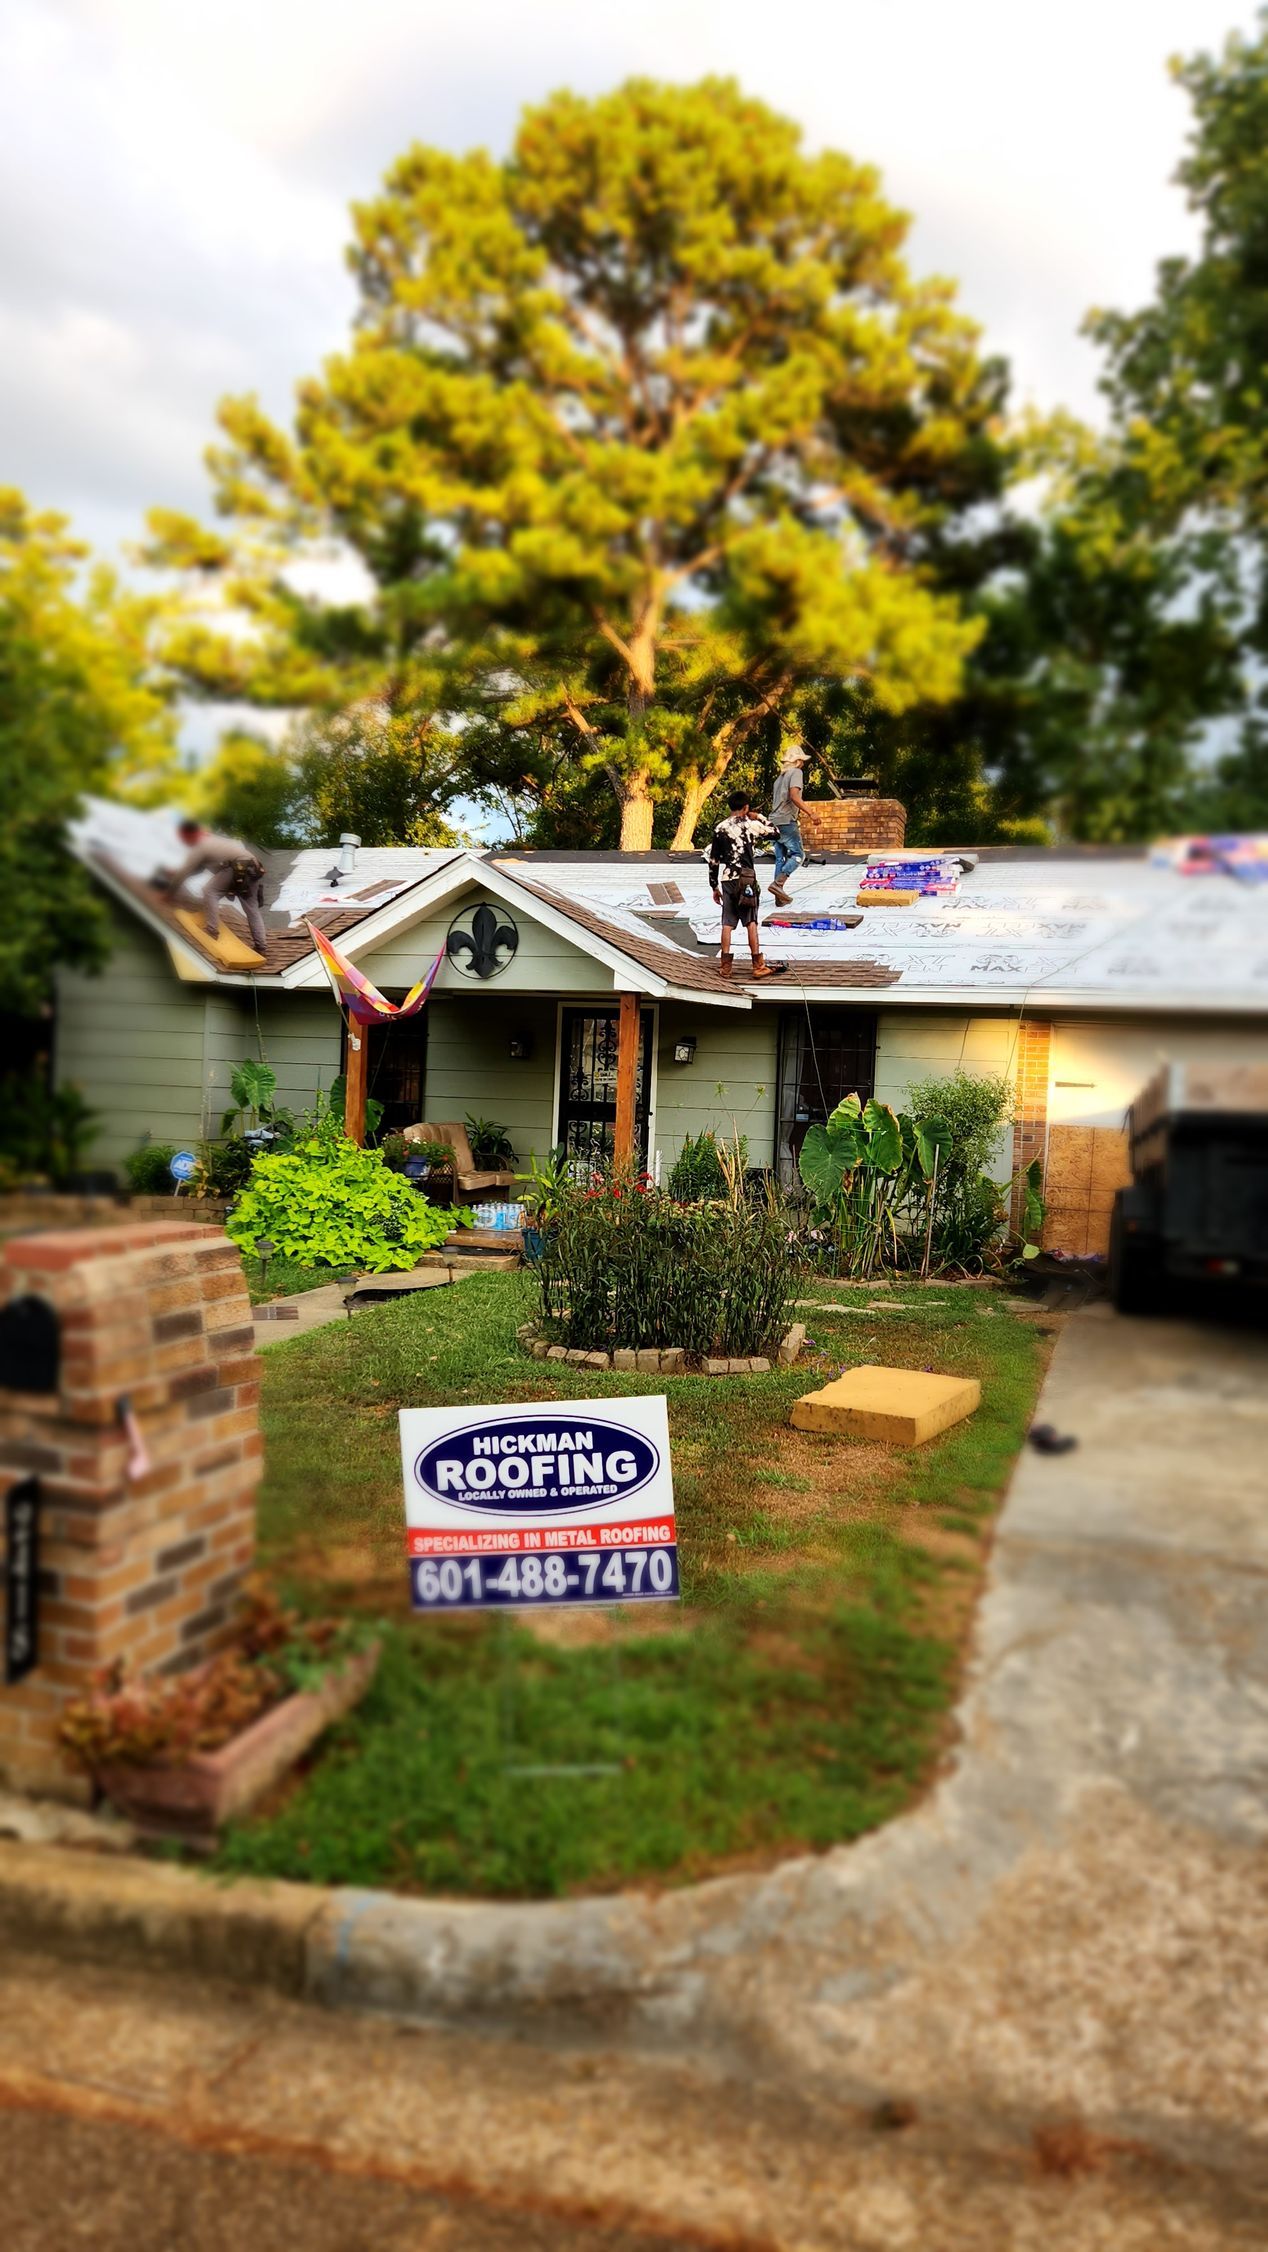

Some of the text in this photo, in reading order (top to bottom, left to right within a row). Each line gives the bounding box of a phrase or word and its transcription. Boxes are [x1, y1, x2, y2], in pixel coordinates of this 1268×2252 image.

[473, 1431, 594, 1456] HICKMAN
[435, 1450, 638, 1492] ROOFING
[458, 1483, 618, 1502] LOCALLY OWNED & OPERATED
[413, 1525, 671, 1552] SPECIALIZING IN METAL ROOFING
[416, 1549, 673, 1602] 601-488-7470
